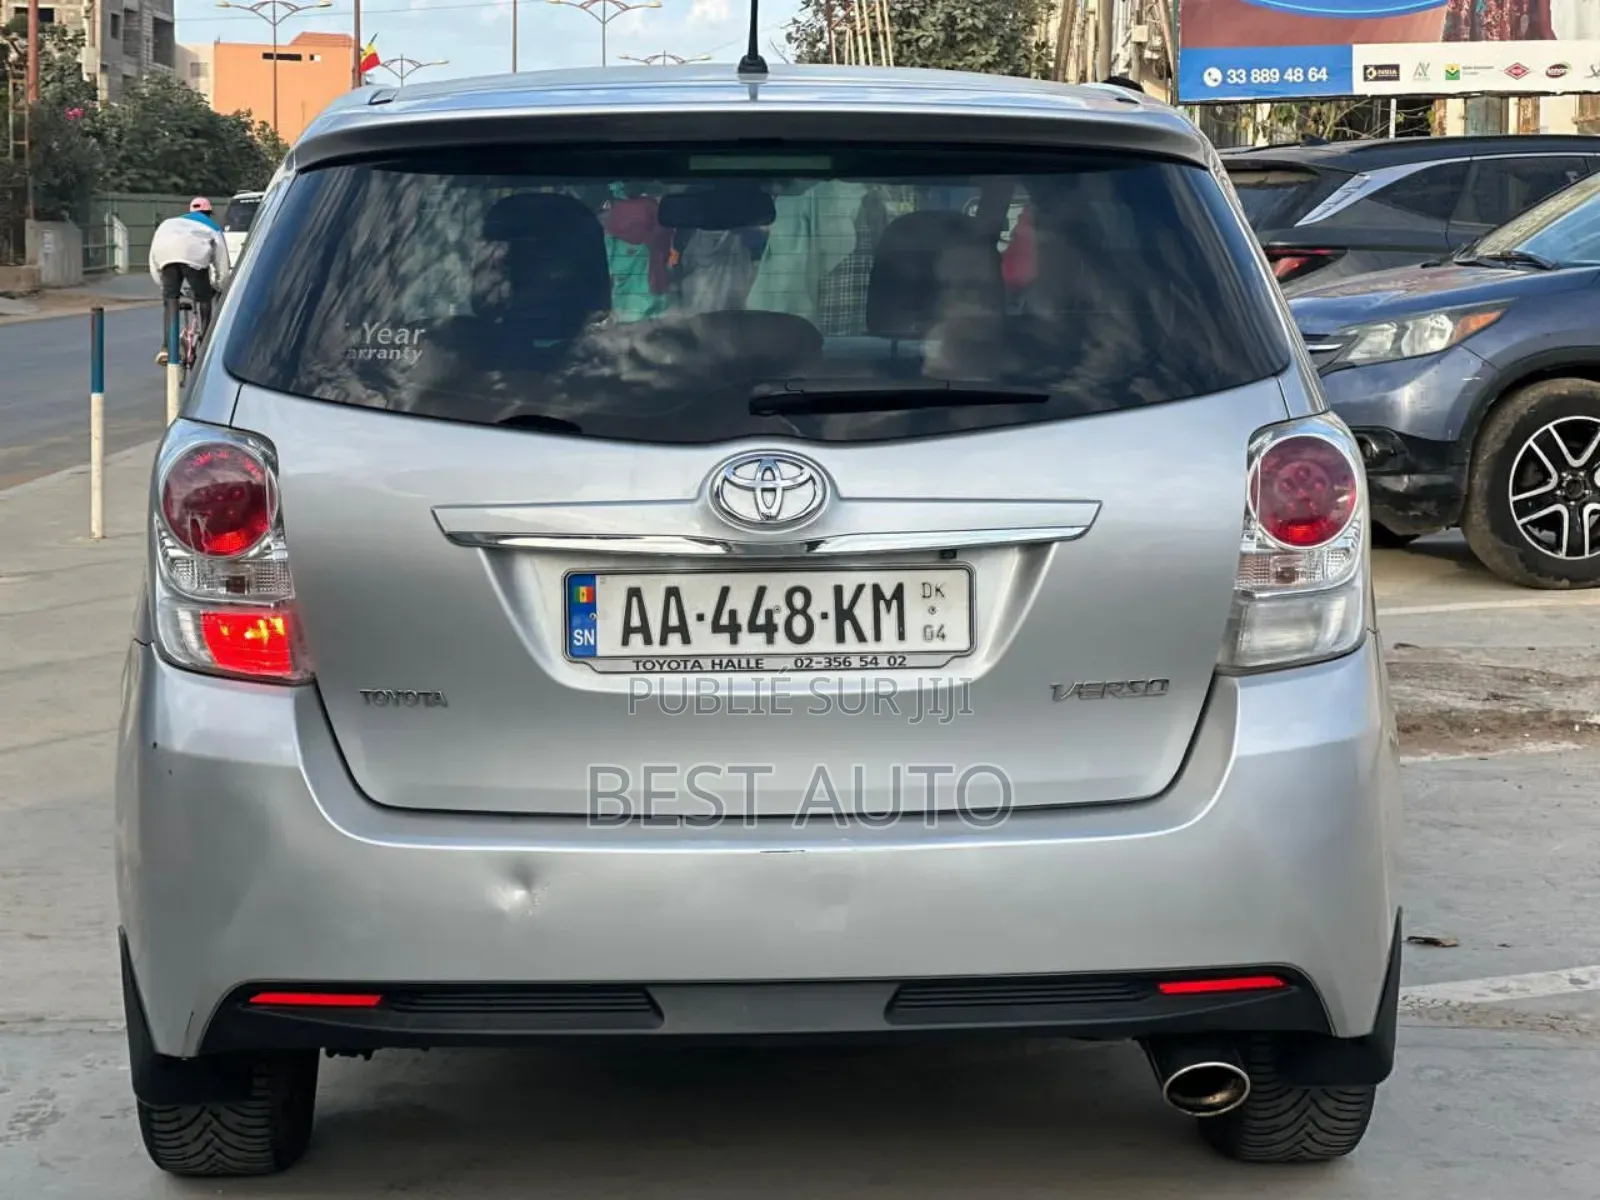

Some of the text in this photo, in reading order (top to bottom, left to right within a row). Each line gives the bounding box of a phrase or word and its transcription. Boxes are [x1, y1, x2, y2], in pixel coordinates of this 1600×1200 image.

[1227, 66, 1328, 84] 33 889 48 64
[362, 322, 426, 345] Year
[346, 347, 423, 365] arranty
[921, 582, 946, 598] DK
[573, 629, 595, 646] SN
[923, 624, 946, 641] 04
[633, 655, 907, 671] TOYOTA HALLE 02-356 54 02
[359, 689, 448, 707] TOYOTA
[1050, 679, 1170, 701] VERSO
